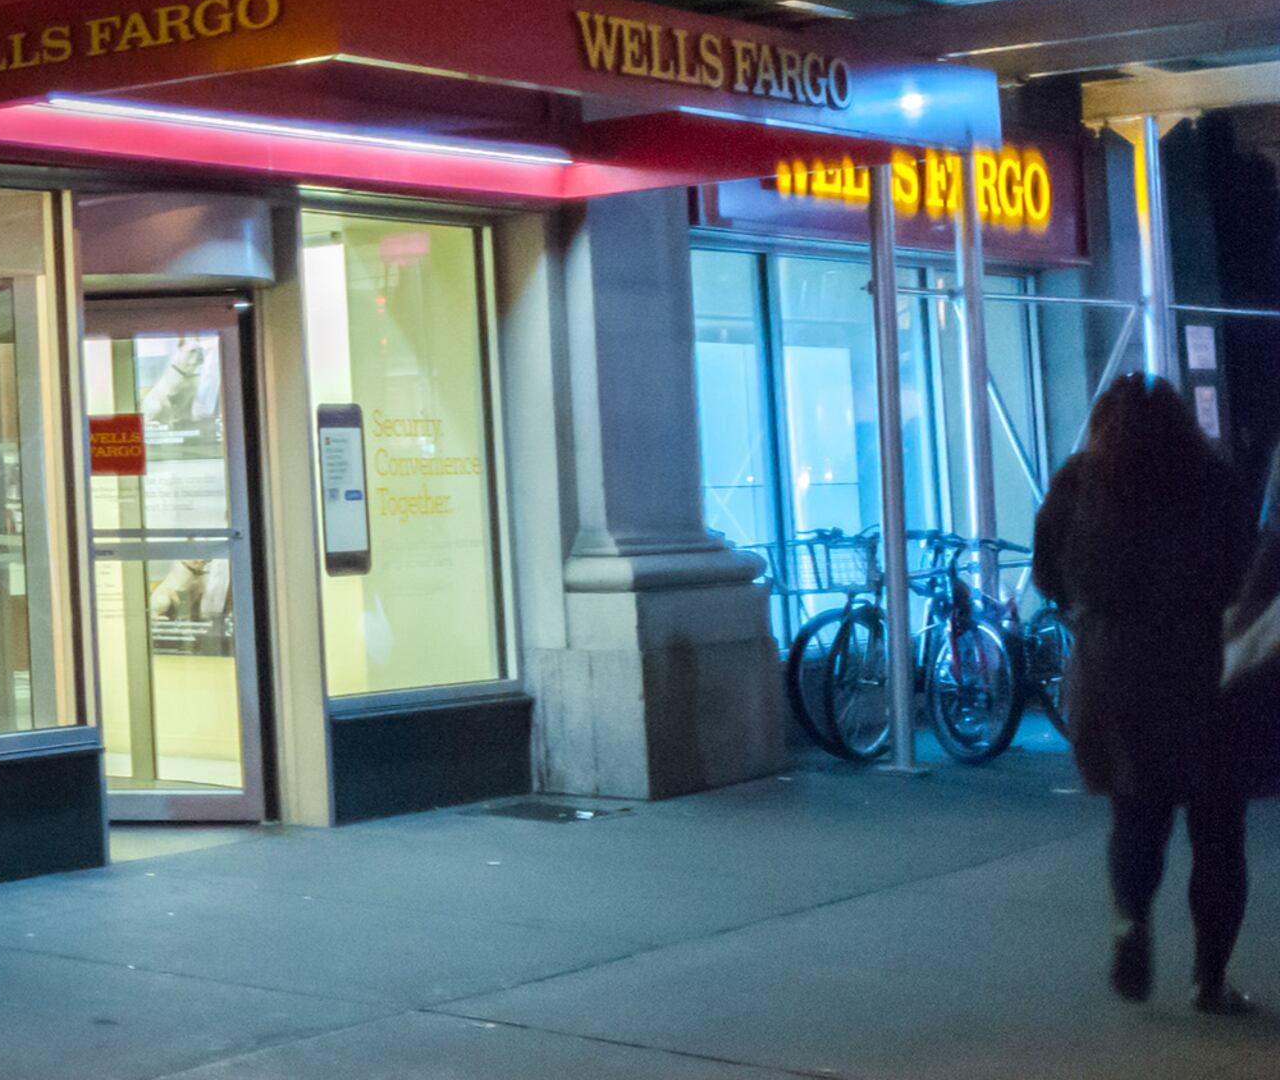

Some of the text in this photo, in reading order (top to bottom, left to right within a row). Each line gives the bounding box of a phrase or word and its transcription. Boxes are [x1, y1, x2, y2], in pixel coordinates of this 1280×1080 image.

[576, 11, 853, 110] WELLS FARGO
[777, 158, 918, 208] ELS
